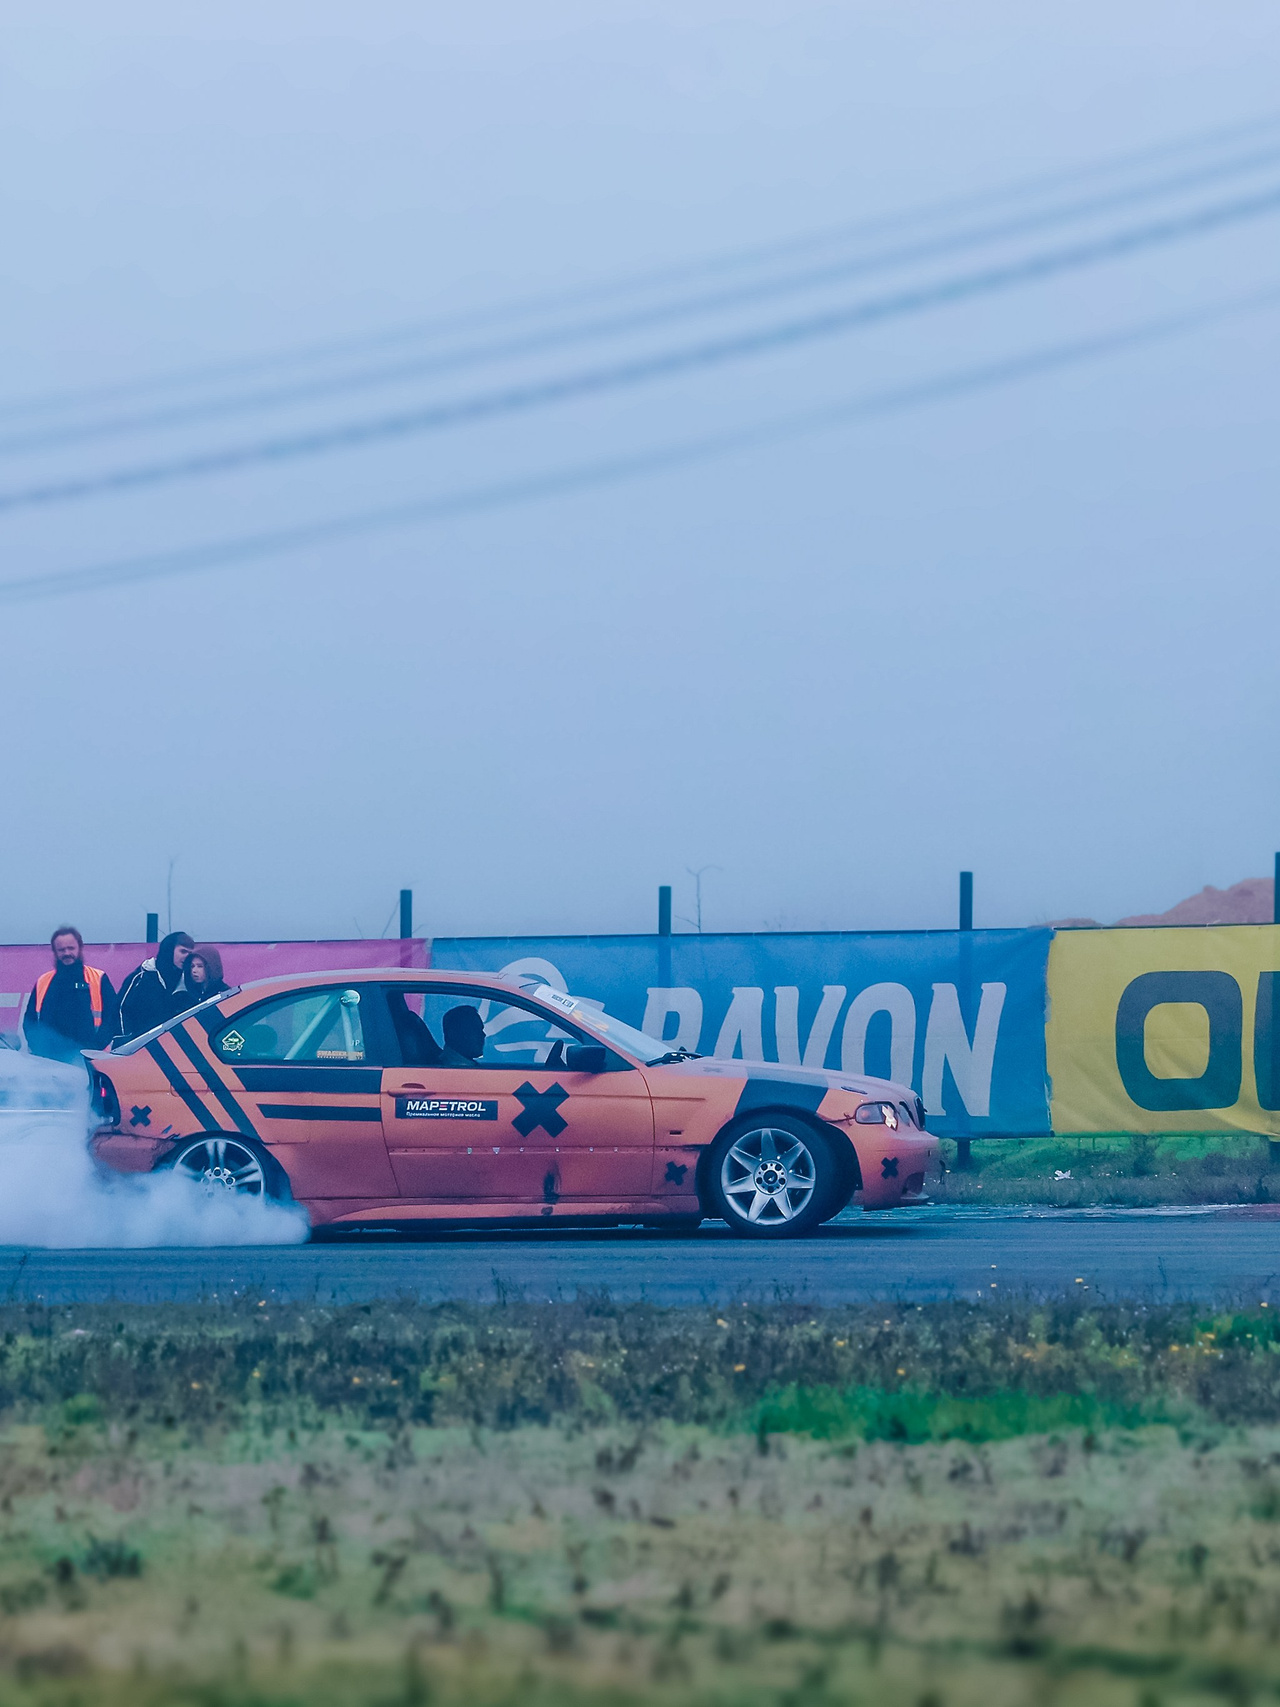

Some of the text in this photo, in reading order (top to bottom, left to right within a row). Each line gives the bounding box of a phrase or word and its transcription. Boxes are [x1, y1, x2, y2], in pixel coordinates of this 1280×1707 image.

[406, 1100, 486, 1111] MAPETROL
[640, 981, 1007, 1117] RAVON
[1115, 970, 1280, 1112] O
